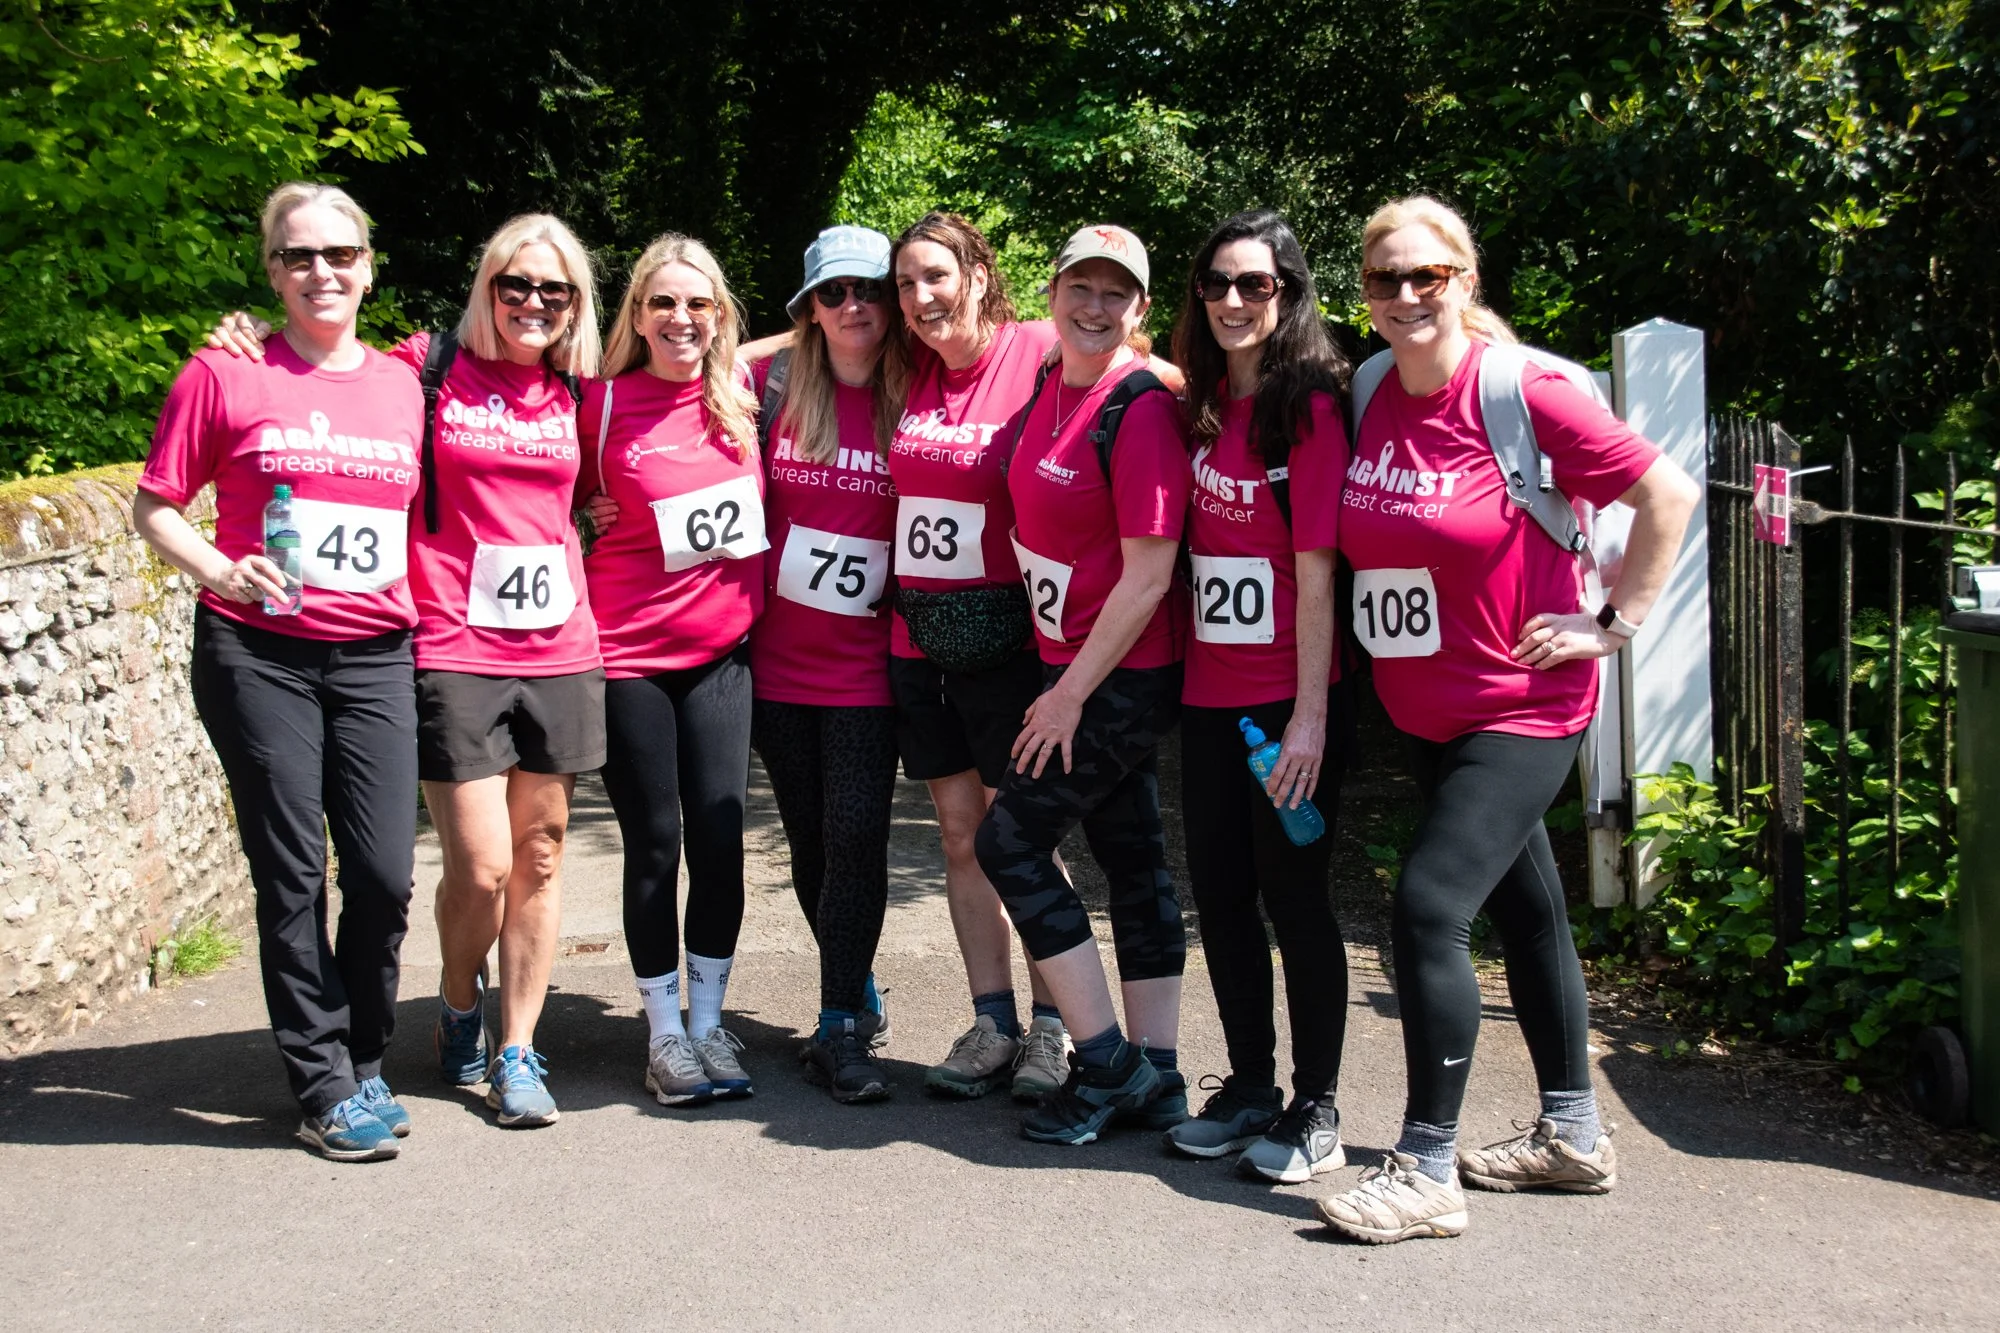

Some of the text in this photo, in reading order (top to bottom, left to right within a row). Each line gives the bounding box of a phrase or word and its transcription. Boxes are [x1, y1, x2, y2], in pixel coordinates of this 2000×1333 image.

[260, 410, 413, 465] AGAINST
[442, 393, 575, 440] AGAINST
[441, 425, 576, 460] breast cancer
[921, 446, 987, 466] cancer
[260, 453, 413, 486] breast cancer
[771, 460, 898, 498] breast cance
[1048, 474, 1072, 486] cancer
[686, 500, 744, 553] 62
[1201, 496, 1255, 523] cancer
[1380, 499, 1448, 519] cancer
[316, 525, 380, 574] 43
[907, 514, 960, 562] 63
[497, 564, 550, 610] 46
[808, 547, 868, 599] 75
[1194, 575, 1265, 625] 120
[1360, 586, 1431, 639] 108
